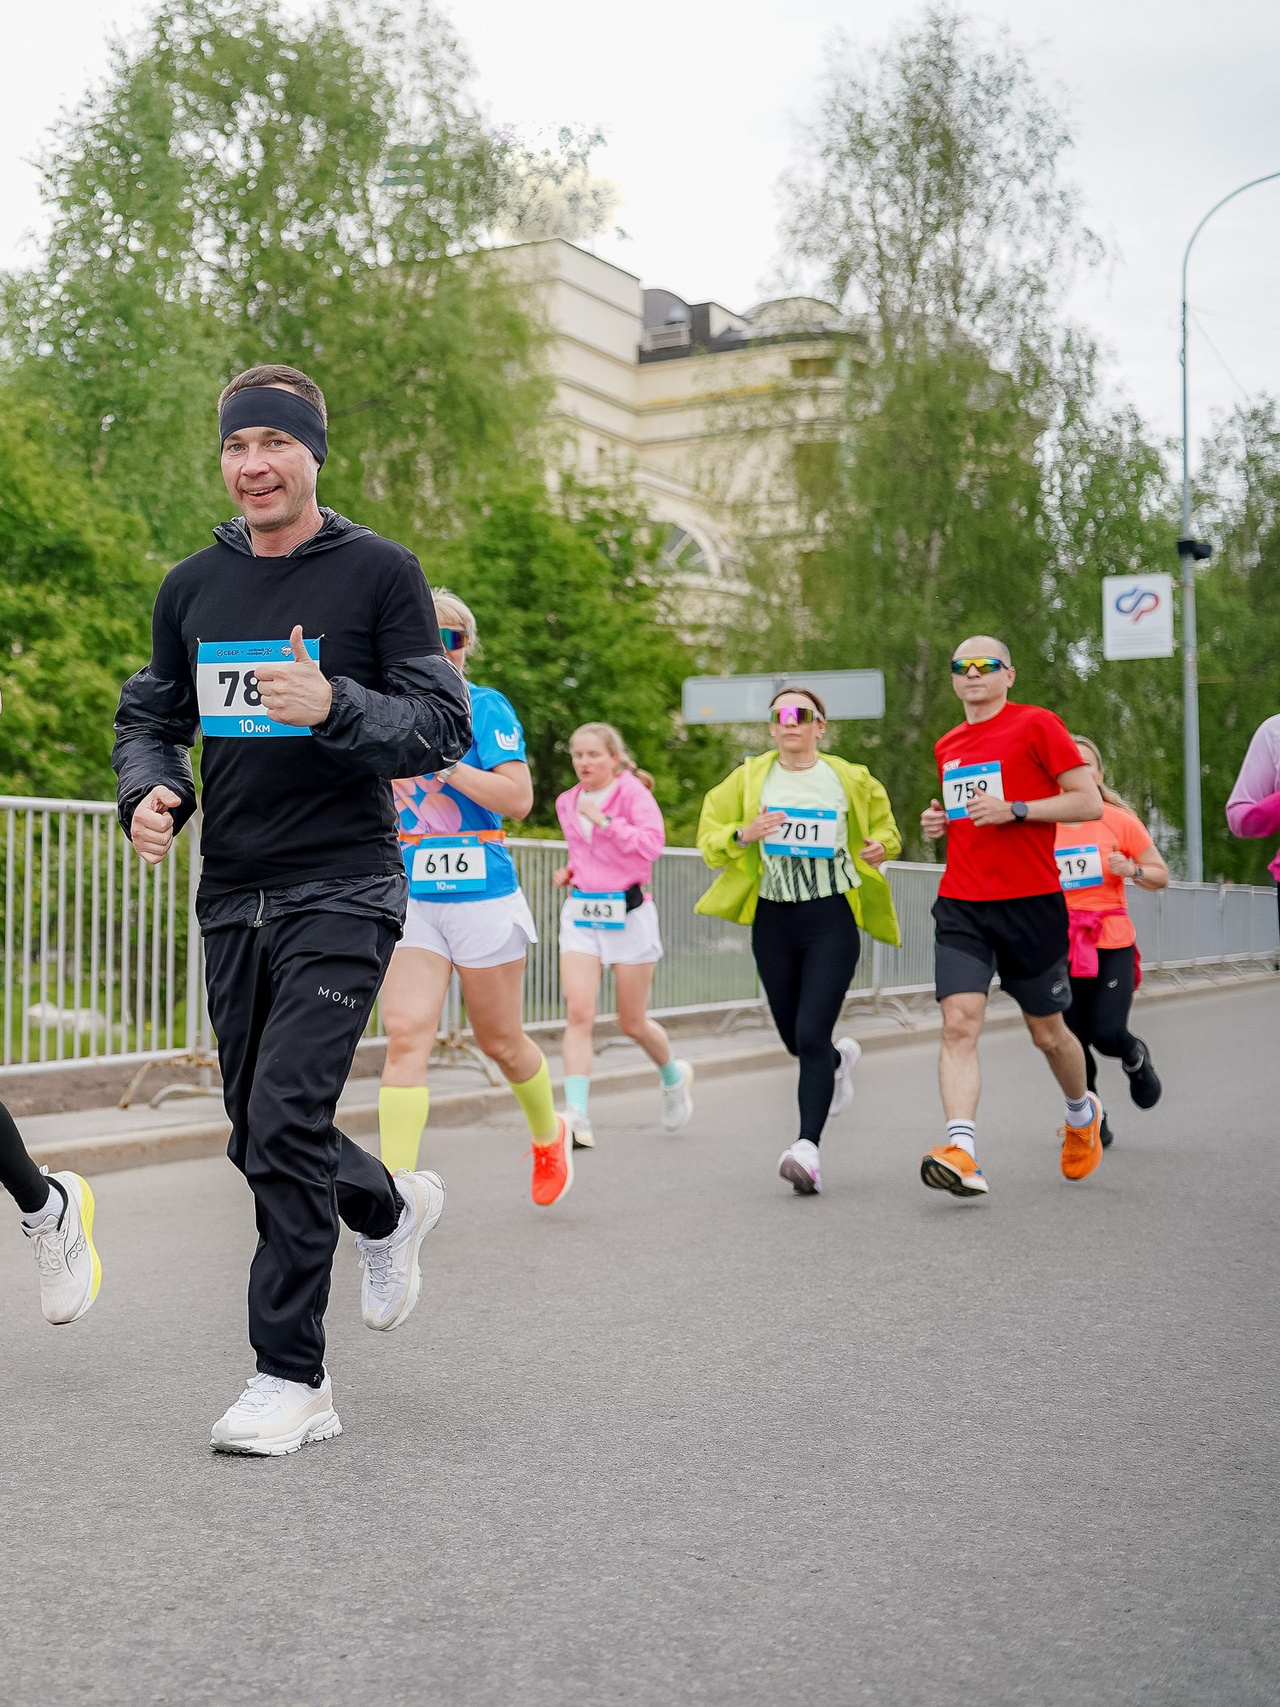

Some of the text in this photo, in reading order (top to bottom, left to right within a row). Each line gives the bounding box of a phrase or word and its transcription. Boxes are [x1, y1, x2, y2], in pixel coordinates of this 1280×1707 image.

[218, 670, 263, 707] 78
[954, 780, 987, 802] 759
[781, 822, 819, 841] 701
[426, 853, 468, 874] 616
[1059, 859, 1087, 875] 19
[317, 986, 356, 1009] MOAX
